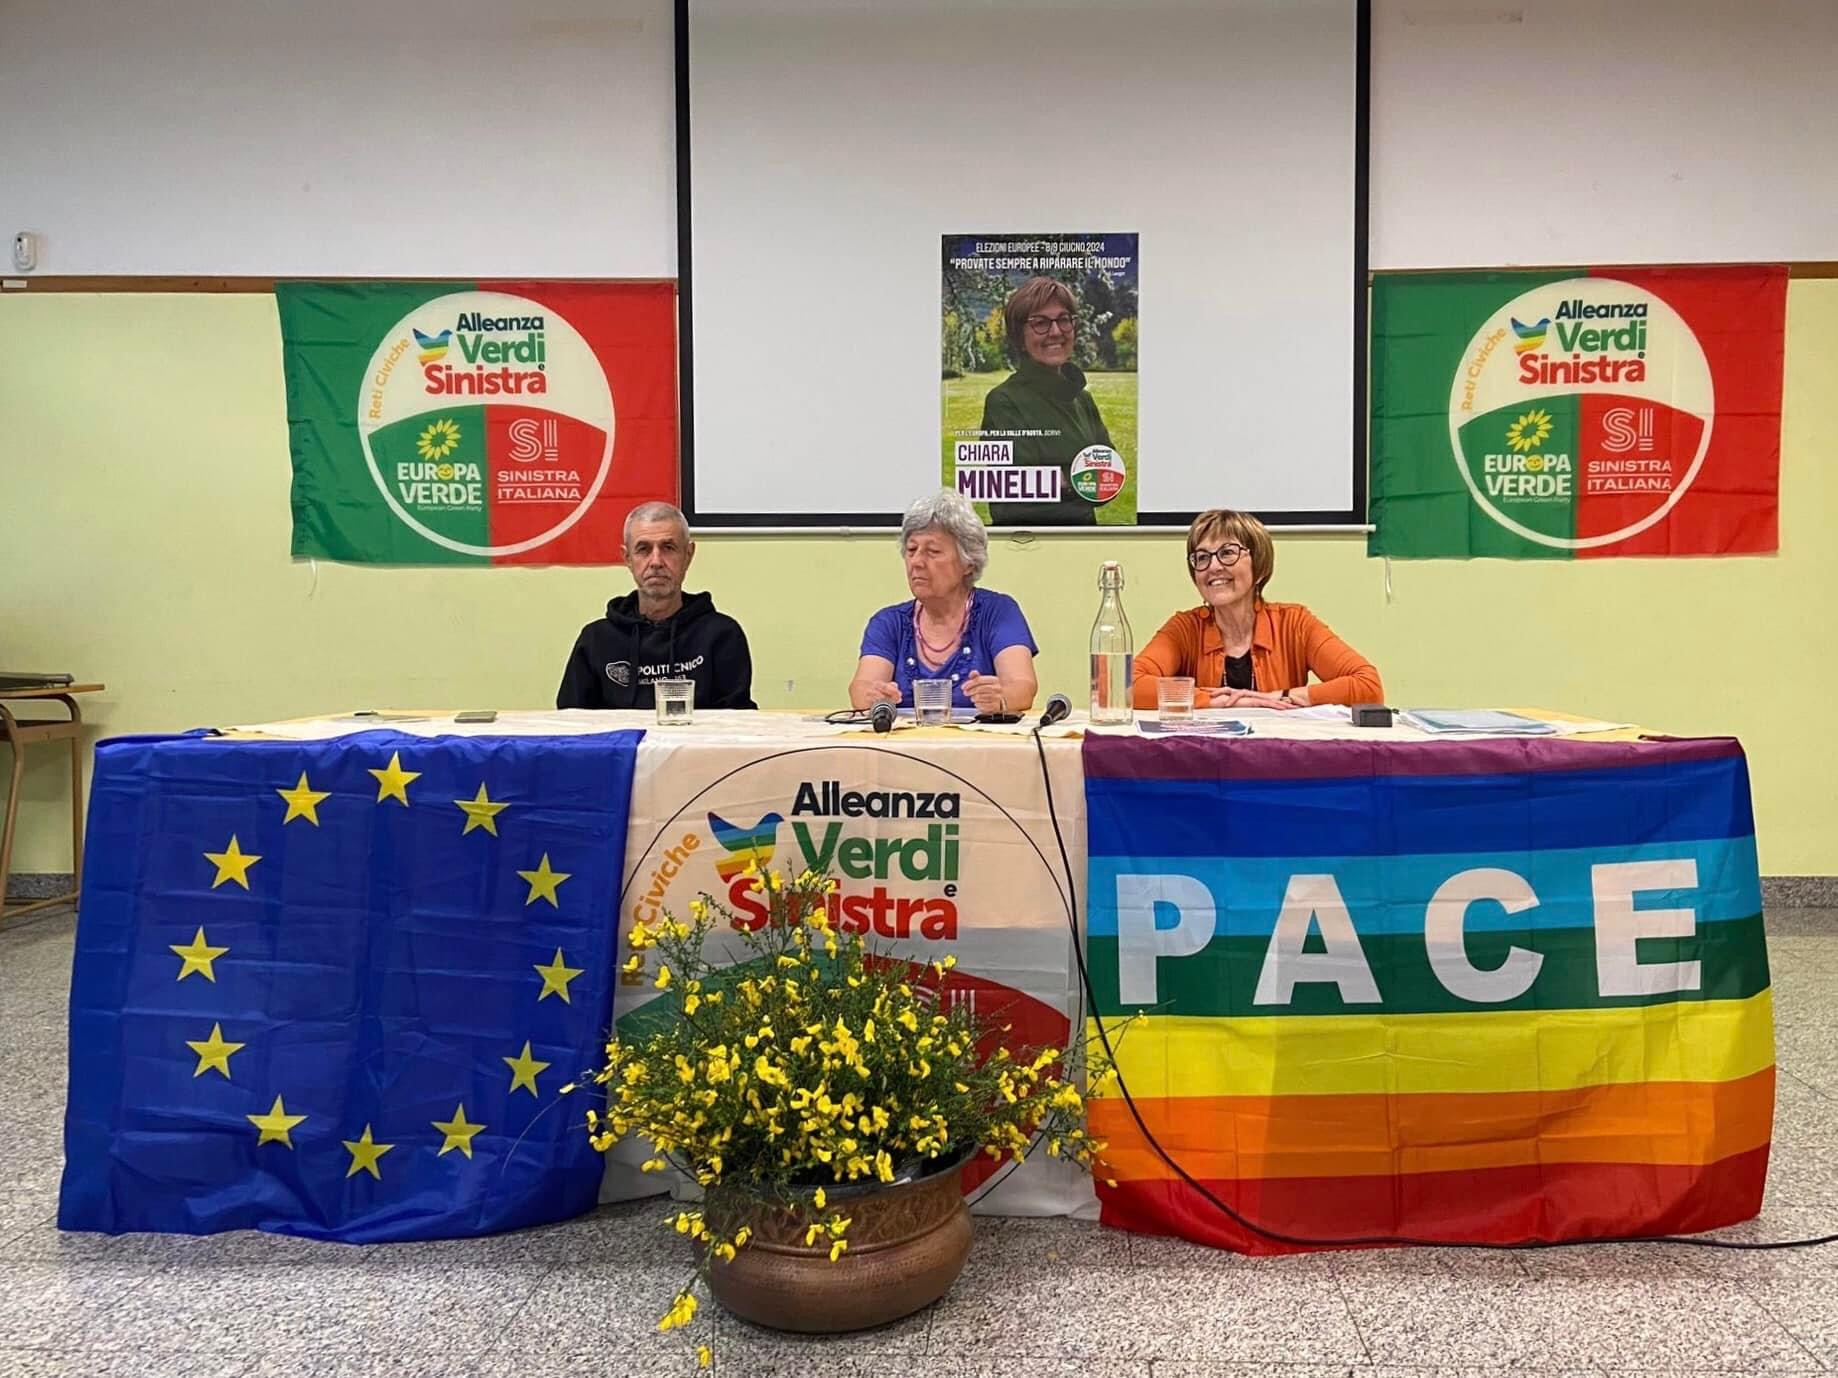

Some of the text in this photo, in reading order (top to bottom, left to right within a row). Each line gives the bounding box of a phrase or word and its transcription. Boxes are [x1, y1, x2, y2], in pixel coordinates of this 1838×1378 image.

[1008, 242, 1040, 252] EUROPEE
[1060, 242, 1085, 252] GIUGNO
[1086, 242, 1104, 252] 2024
[996, 258, 1032, 269] SEMPRE
[1033, 258, 1040, 269] A
[1040, 258, 1084, 269] RIPARARE
[1085, 258, 1093, 268] IL
[1555, 300, 1648, 320] Alleanza
[456, 313, 544, 332] Alleanza
[1556, 320, 1646, 352] Verdi
[456, 333, 546, 364] Verdi
[370, 338, 410, 420] Reti Civiche
[1461, 328, 1506, 412] Reti Civiche
[1519, 353, 1645, 385] Sinistra
[425, 364, 546, 395] Sinistra
[958, 444, 1010, 462] CHIARA
[397, 462, 481, 481] EUROPA
[1484, 454, 1571, 473] EUROPA
[1587, 460, 1672, 473] SINISTRA
[497, 470, 580, 482] SINISTRA
[958, 470, 1056, 498] MINELLI
[1484, 475, 1572, 496] VERDE
[1587, 478, 1672, 490] ITALIANA
[398, 483, 482, 505] VERDE
[498, 488, 581, 500] ITALIANA
[638, 656, 704, 676] POLITCNICO
[791, 781, 960, 818] Alleanza
[791, 822, 959, 881] Verdi
[632, 832, 700, 926] Civiche
[944, 884, 958, 898] e
[1115, 858, 1701, 1006] PACE
